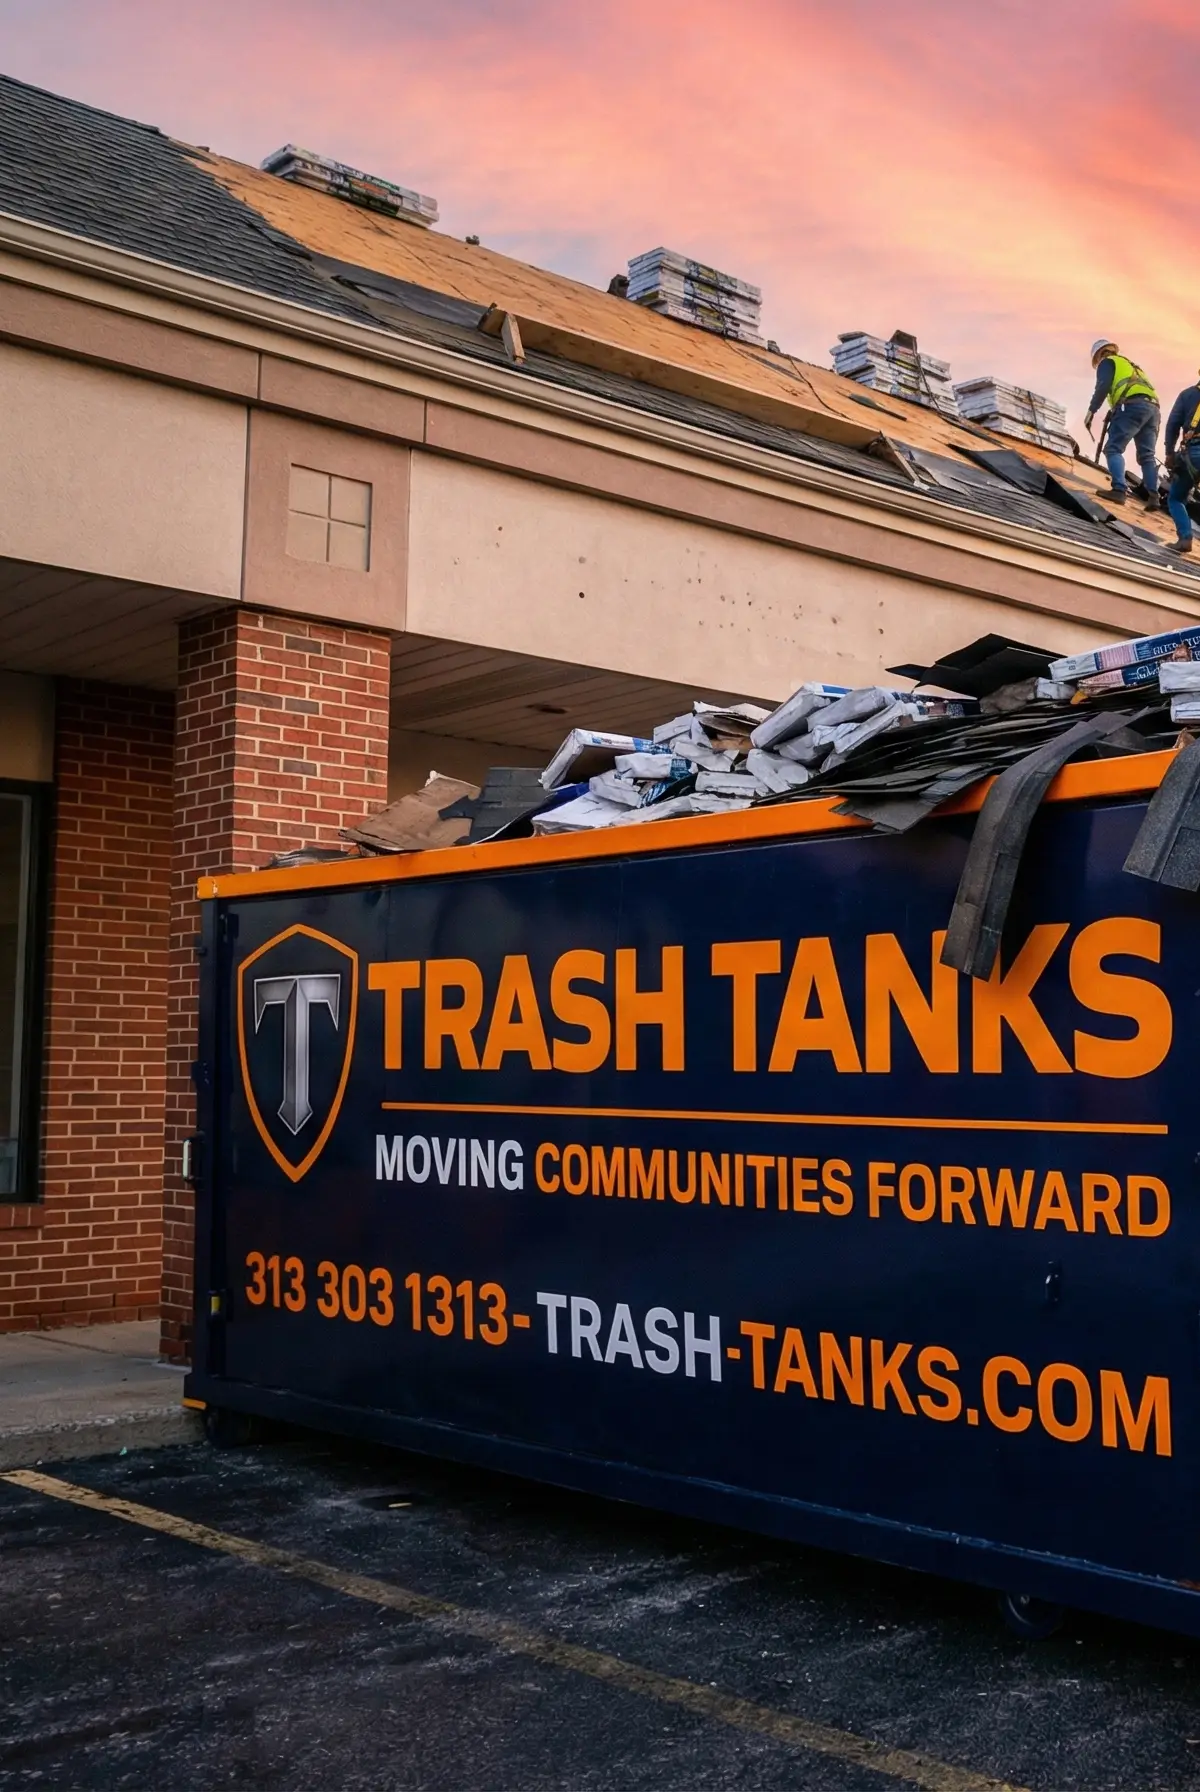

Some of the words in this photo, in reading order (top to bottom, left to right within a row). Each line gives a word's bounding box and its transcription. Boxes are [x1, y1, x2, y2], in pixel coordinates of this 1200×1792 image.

[367, 945, 685, 1074] TRASH
[711, 916, 1173, 1079] TANKS
[375, 1134, 524, 1191] MOVING
[535, 1142, 854, 1216] COMMUNITIES
[868, 1161, 1171, 1238] FORWARD
[246, 1251, 306, 1312] 313
[317, 1260, 394, 1327] 303
